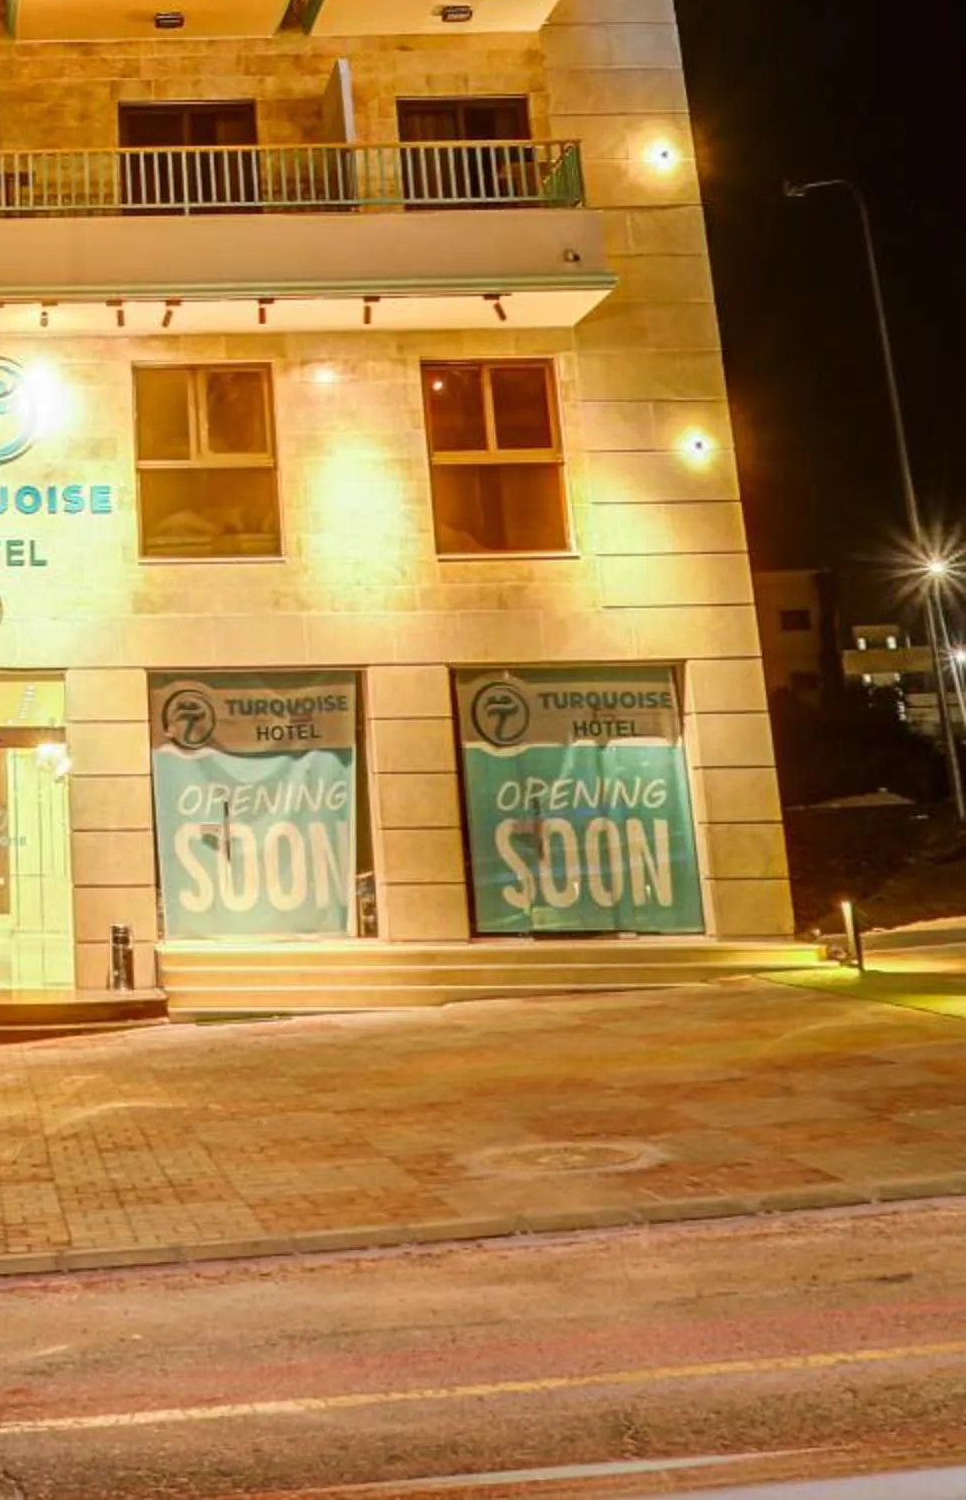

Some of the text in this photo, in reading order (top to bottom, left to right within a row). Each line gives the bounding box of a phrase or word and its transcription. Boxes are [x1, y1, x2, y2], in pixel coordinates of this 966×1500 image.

[226, 695, 349, 717] TURQUOISE
[538, 691, 673, 711] TURQUOISE
[256, 723, 323, 741] HOTEL
[573, 720, 640, 737] HOTEL
[178, 777, 348, 818] OPENING
[497, 776, 667, 812] OPENING
[174, 817, 352, 912] SOON
[495, 817, 672, 908] SOON
